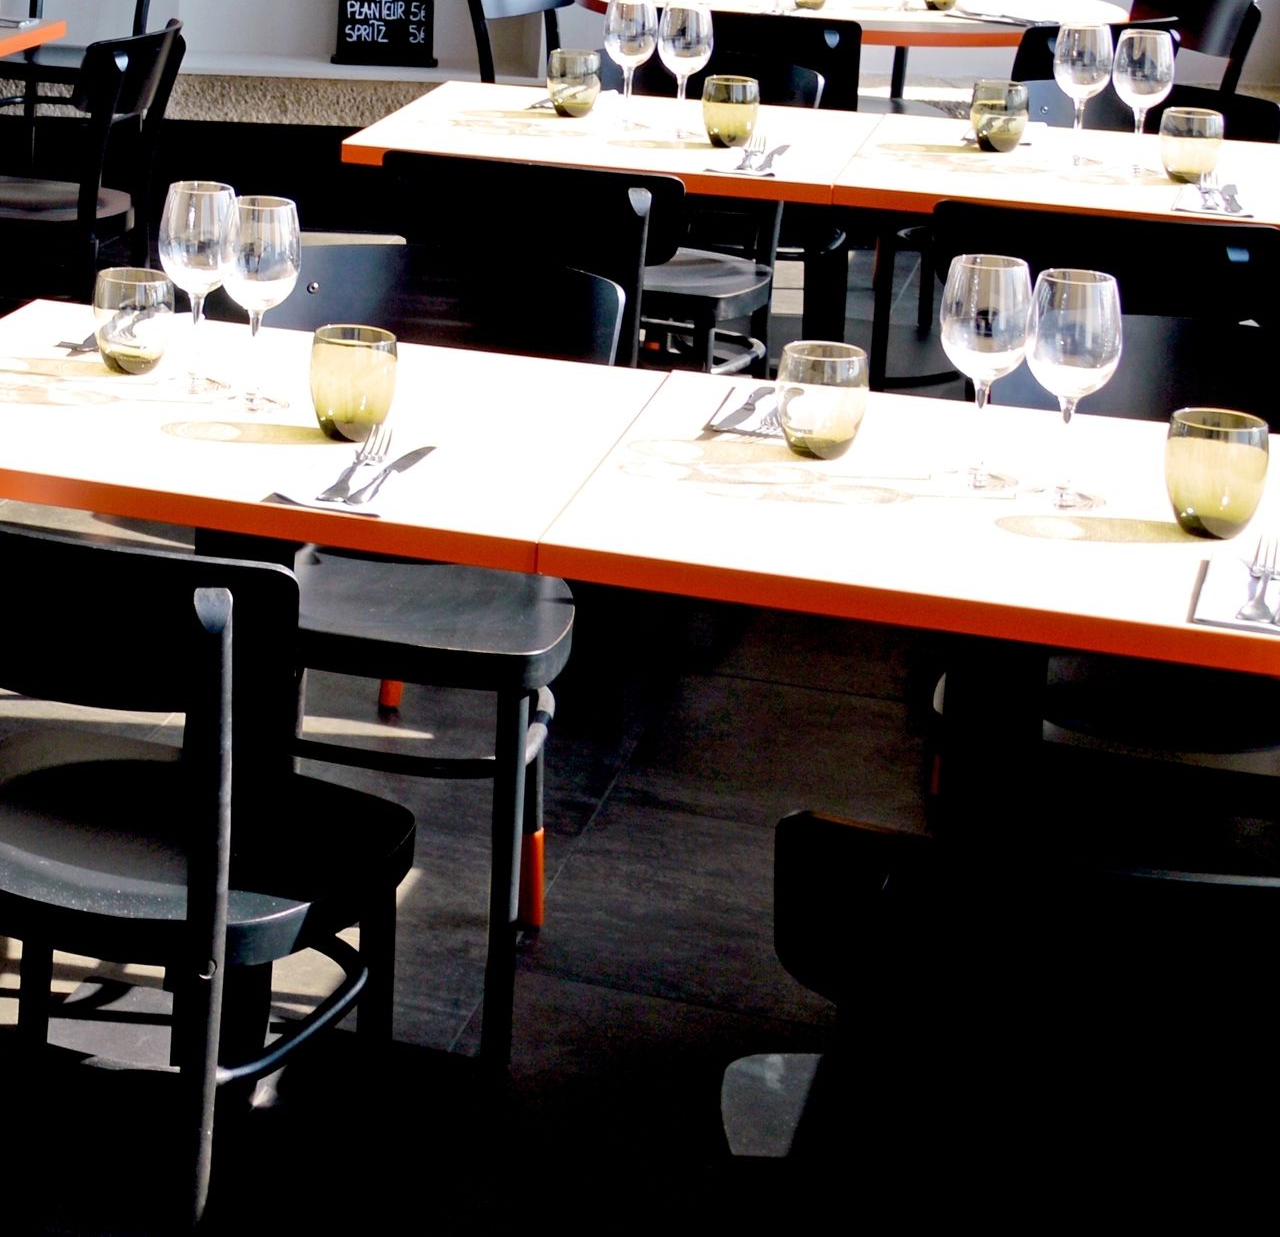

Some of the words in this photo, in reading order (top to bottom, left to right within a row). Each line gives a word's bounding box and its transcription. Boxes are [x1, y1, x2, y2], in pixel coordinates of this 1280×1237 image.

[409, 1, 426, 22] 5€
[345, 20, 389, 43] SPRITZ
[409, 24, 425, 44] 5€
